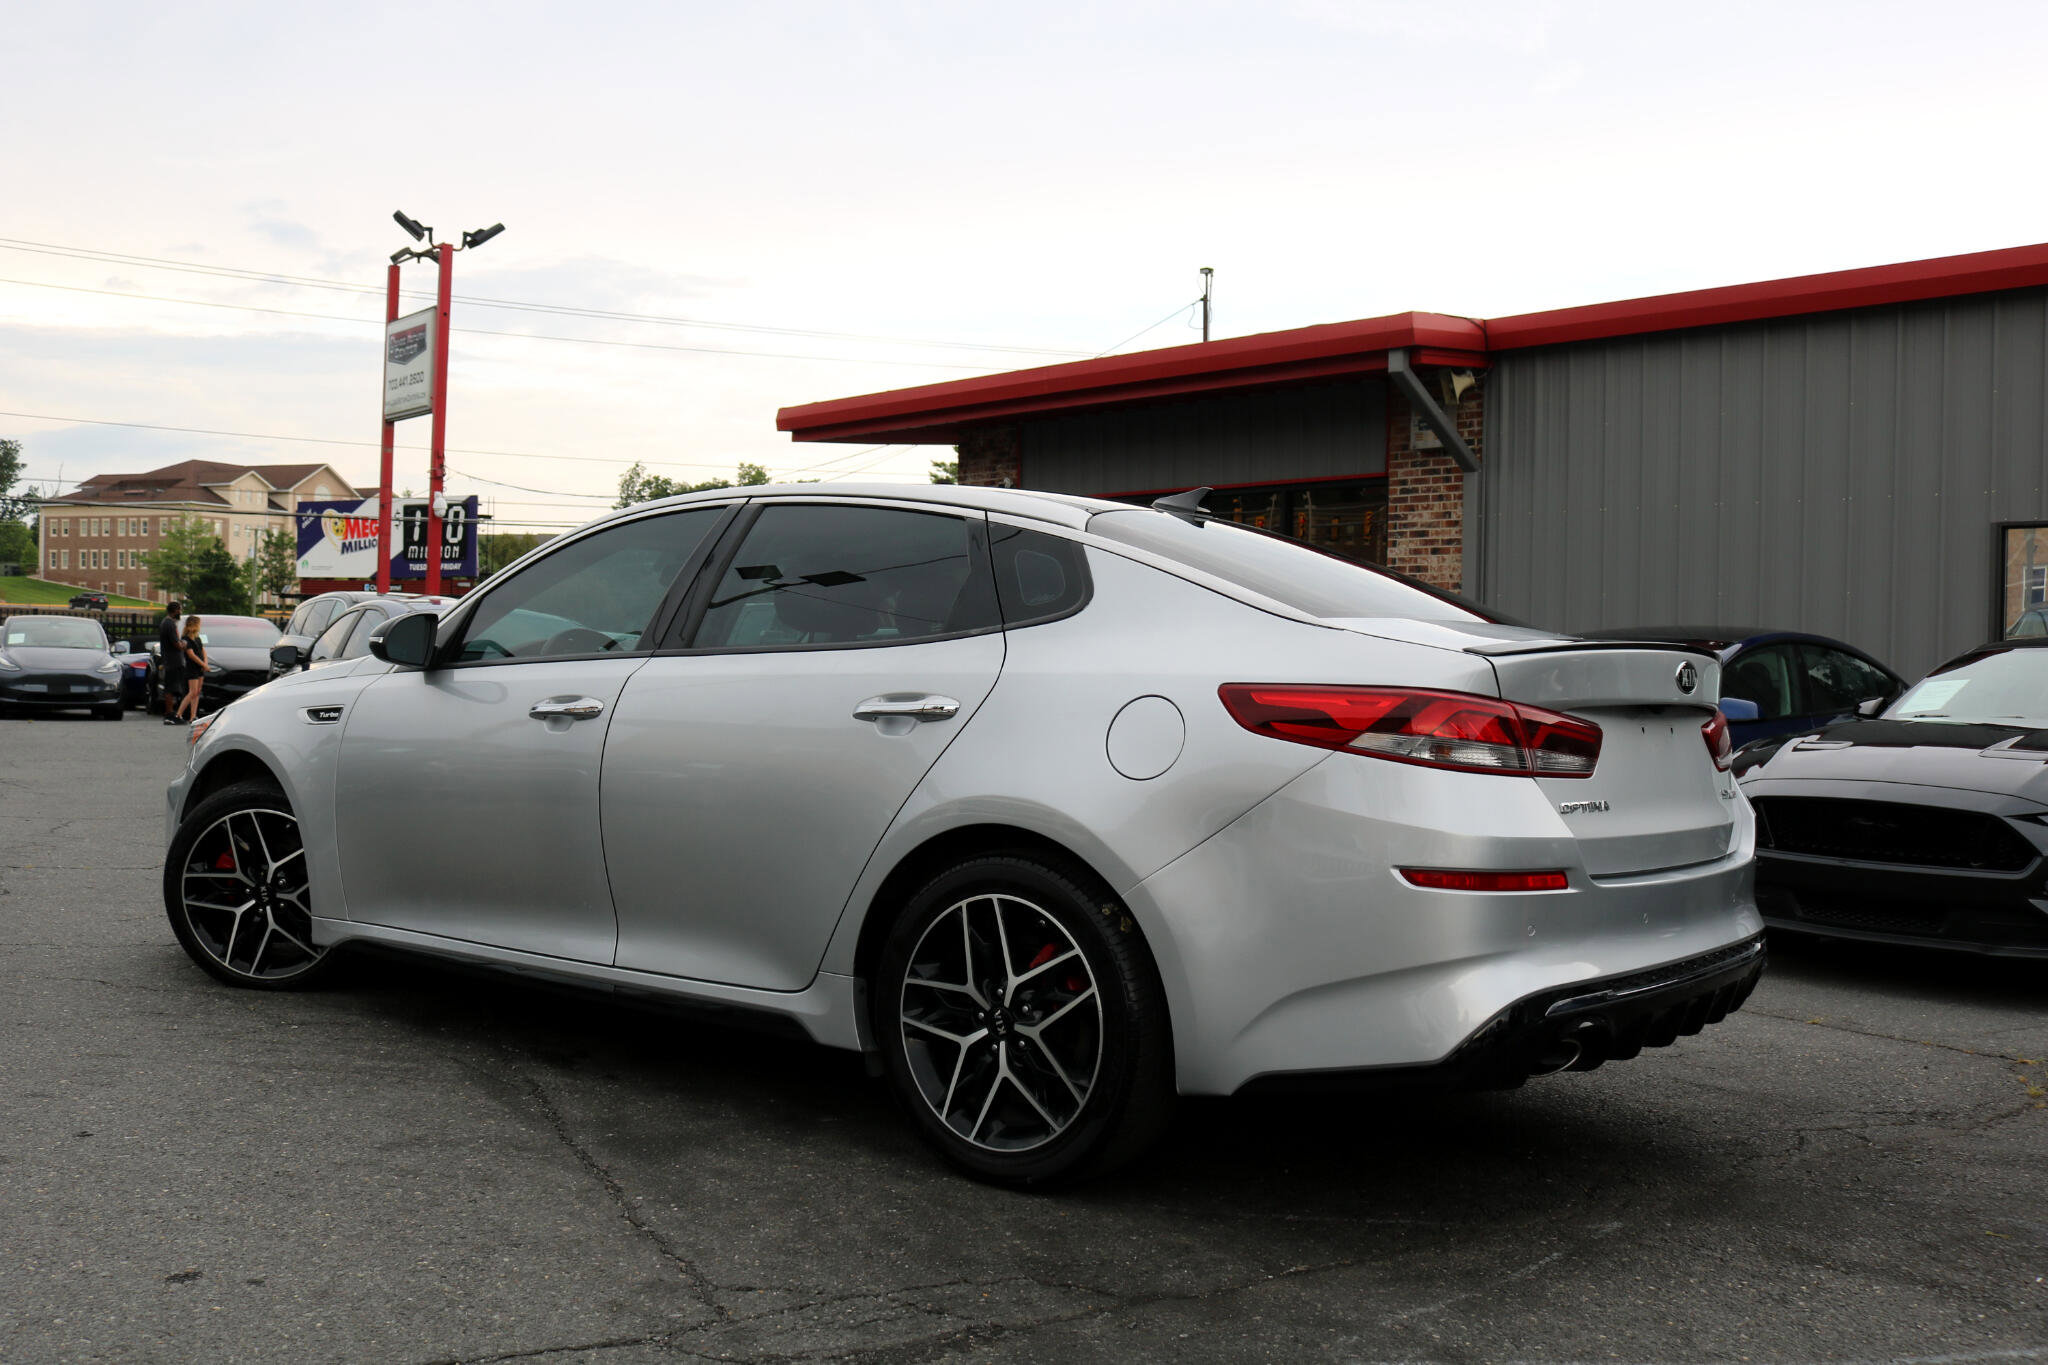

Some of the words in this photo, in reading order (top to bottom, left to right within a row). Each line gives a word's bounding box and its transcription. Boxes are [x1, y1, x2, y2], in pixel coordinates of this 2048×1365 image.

[344, 517, 379, 539] MEG
[341, 539, 377, 554] MILLIO
[440, 563, 462, 571] FRIDAY
[1560, 801, 1610, 814] OPTIMA
